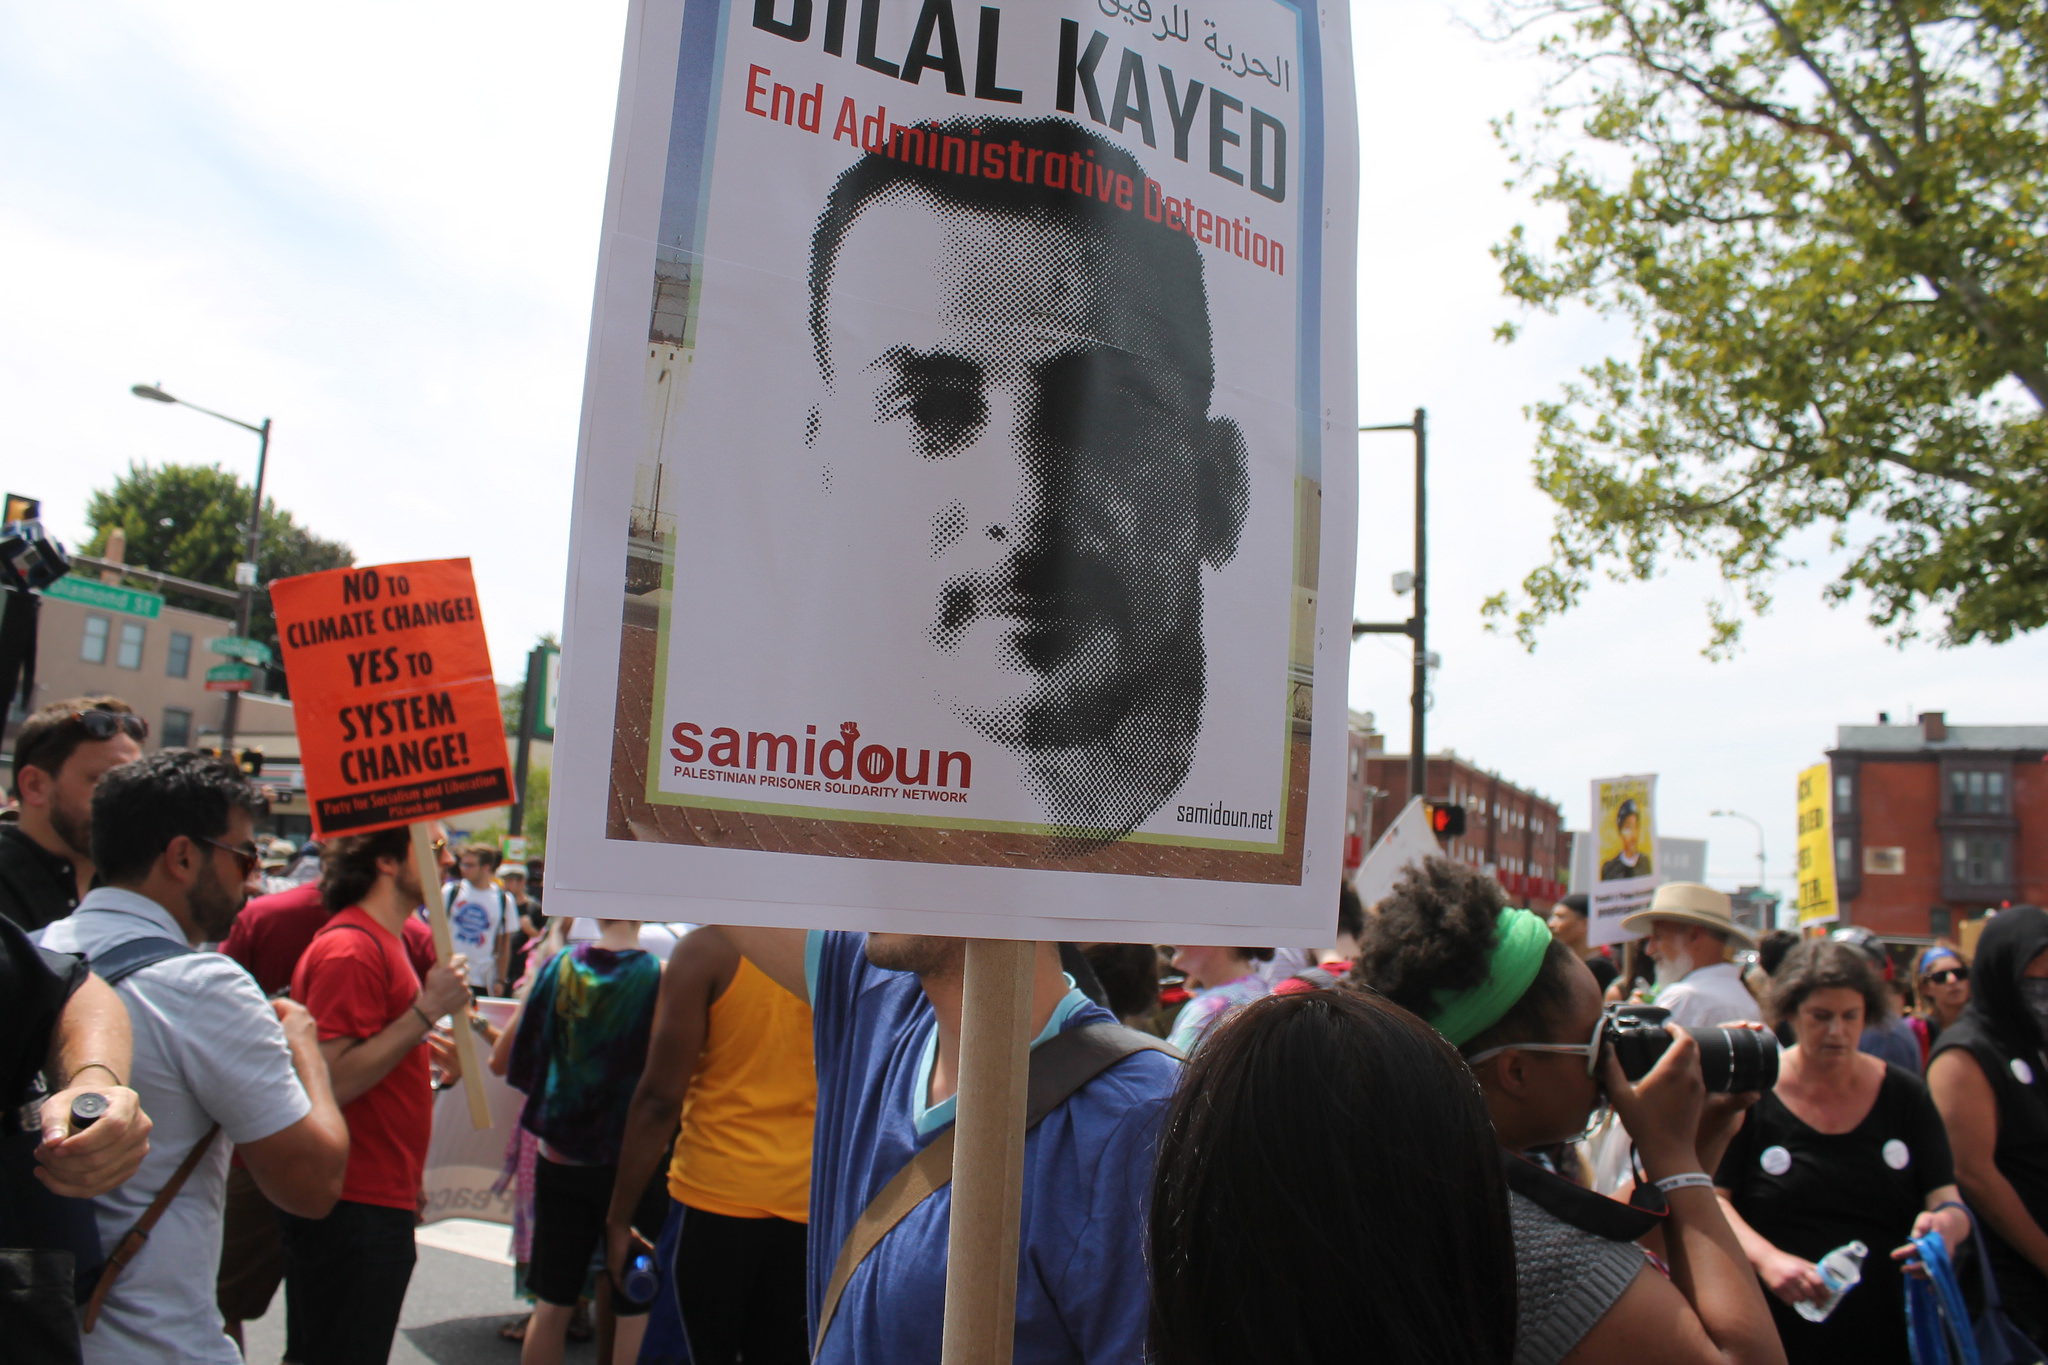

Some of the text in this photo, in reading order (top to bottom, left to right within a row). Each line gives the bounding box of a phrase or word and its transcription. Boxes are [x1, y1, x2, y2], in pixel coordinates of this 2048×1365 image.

[1204, 18, 1290, 92] الحرية
[1056, 18, 1287, 203] KAYED
[745, 63, 1286, 277] End Administrative Detention
[343, 570, 410, 604] NO TO
[287, 597, 475, 649] CLIMATE CHANGE!
[347, 647, 433, 687] YES TO
[338, 691, 456, 742] SYSTEM
[340, 732, 471, 785] CHANGE!
[669, 721, 972, 789] samidoun
[673, 766, 968, 803] PALESTINIAN PRISONER SOLIDARITY NETWORK
[1177, 800, 1273, 830] samidoun.net
